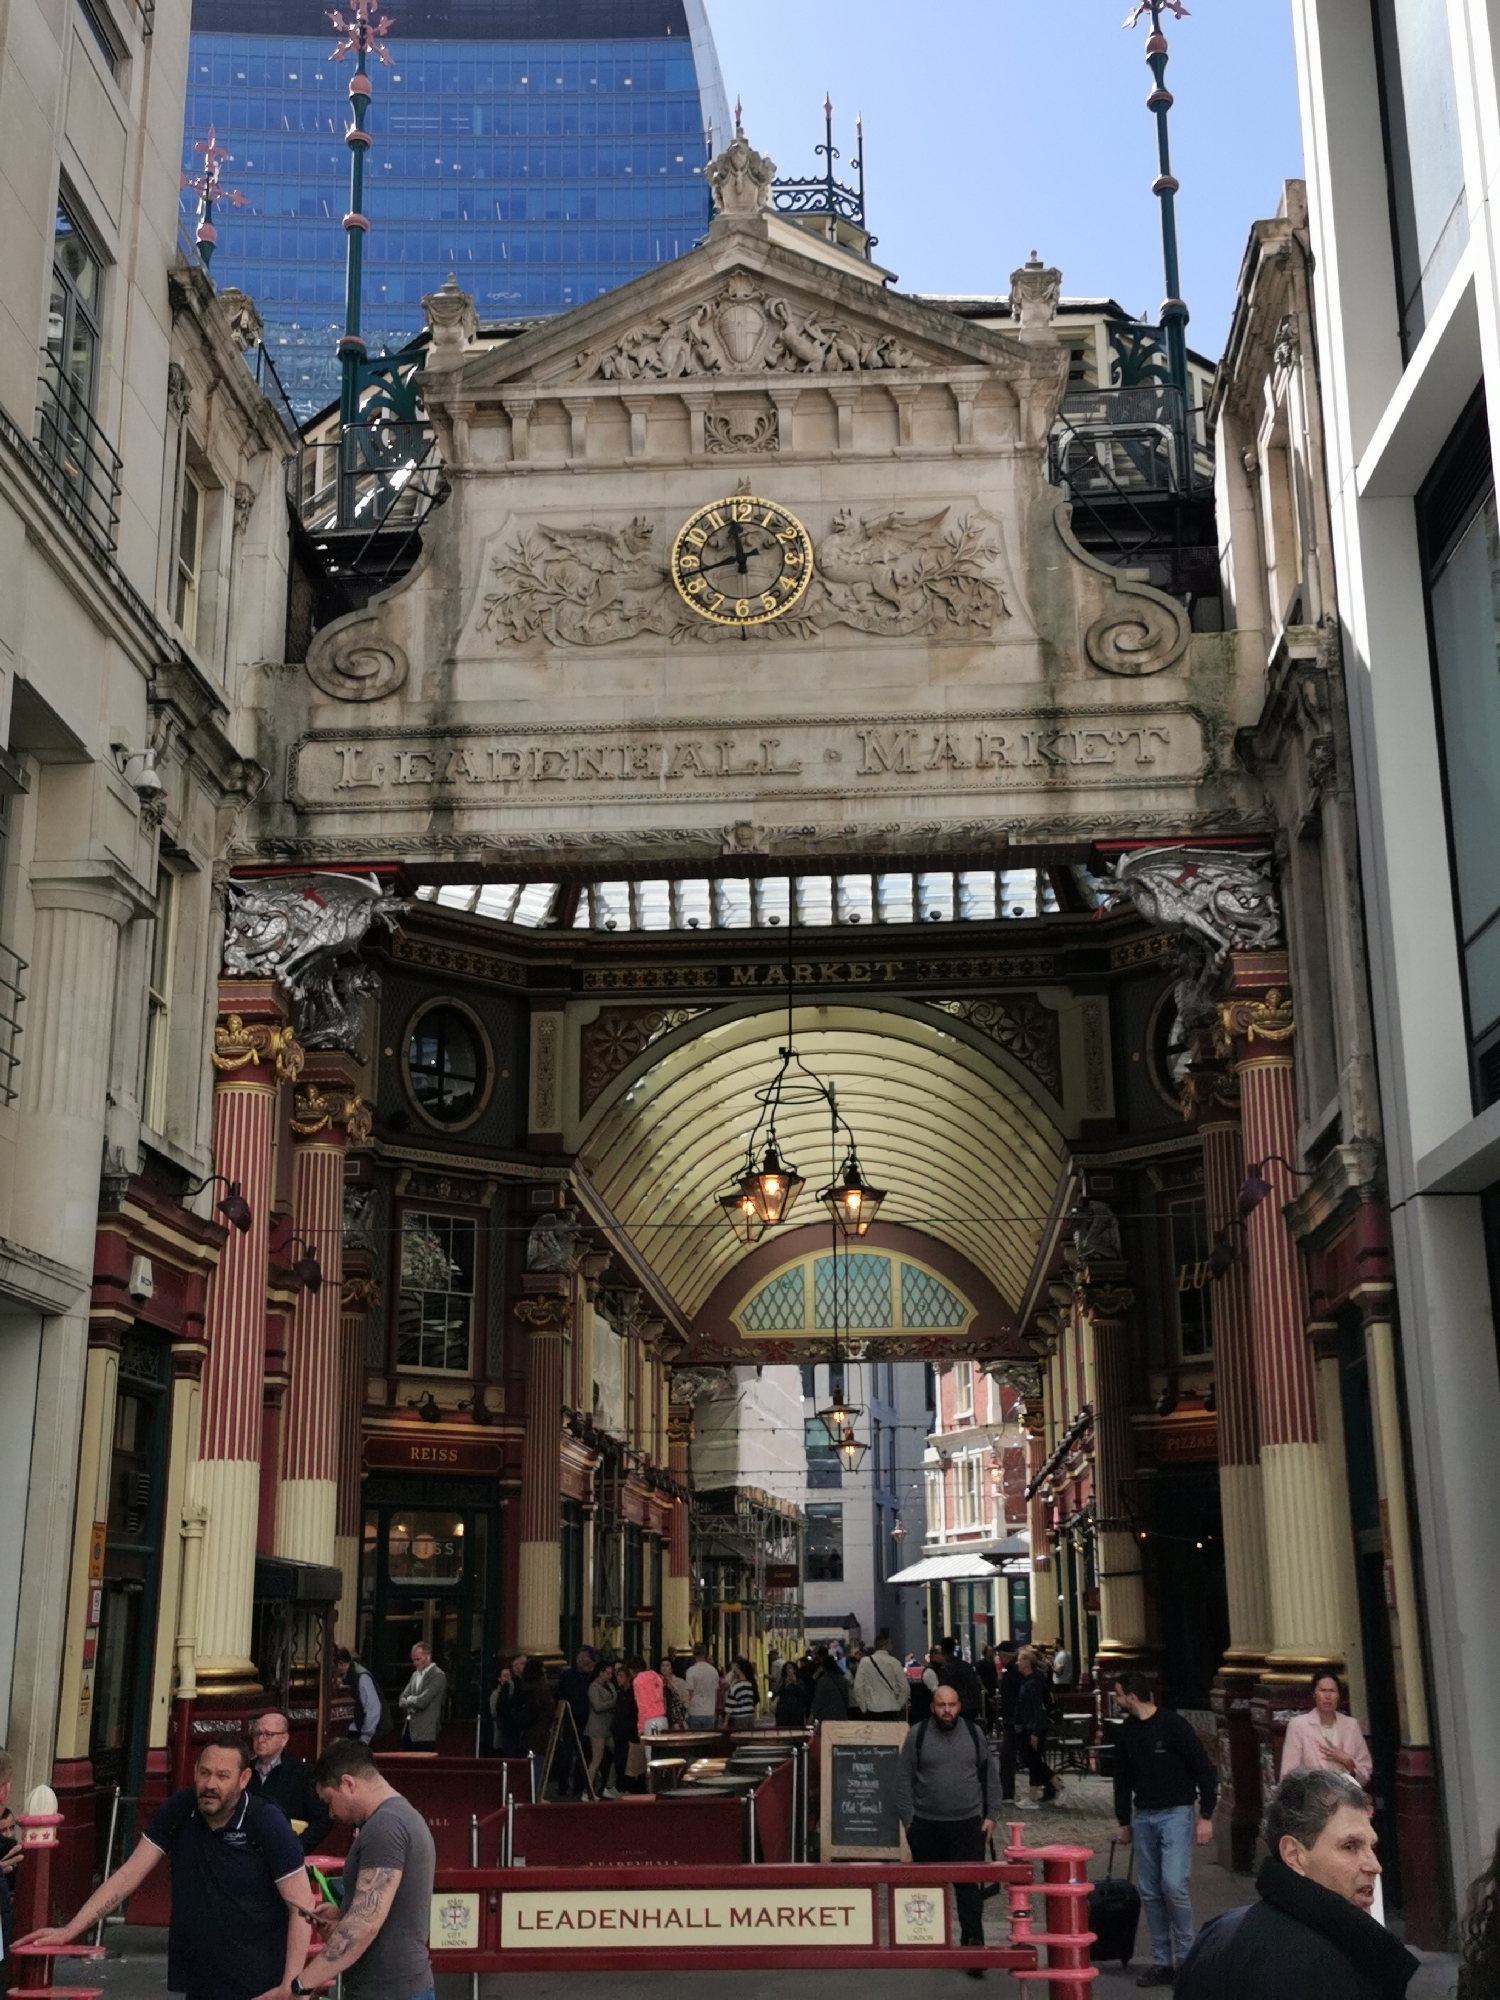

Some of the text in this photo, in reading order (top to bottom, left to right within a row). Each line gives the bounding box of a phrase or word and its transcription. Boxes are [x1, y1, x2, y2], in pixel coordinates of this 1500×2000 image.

[707, 511, 725, 530] 11
[731, 504, 752, 522] 12
[761, 511, 774, 527] 1
[685, 527, 708, 548] 10
[775, 526, 797, 544] 2
[679, 555, 700, 568] 9
[784, 552, 804, 565] 3
[687, 578, 707, 594] 8
[779, 576, 798, 591] 4
[710, 593, 725, 611] 7
[735, 598, 750, 617] 6
[760, 590, 777, 611] 5
[333, 728, 1171, 790] LEADENHALL MARKET
[730, 961, 904, 986] MARKET
[410, 1446, 458, 1461] REISS
[517, 1906, 856, 1930] LEADENHALL MARKET
